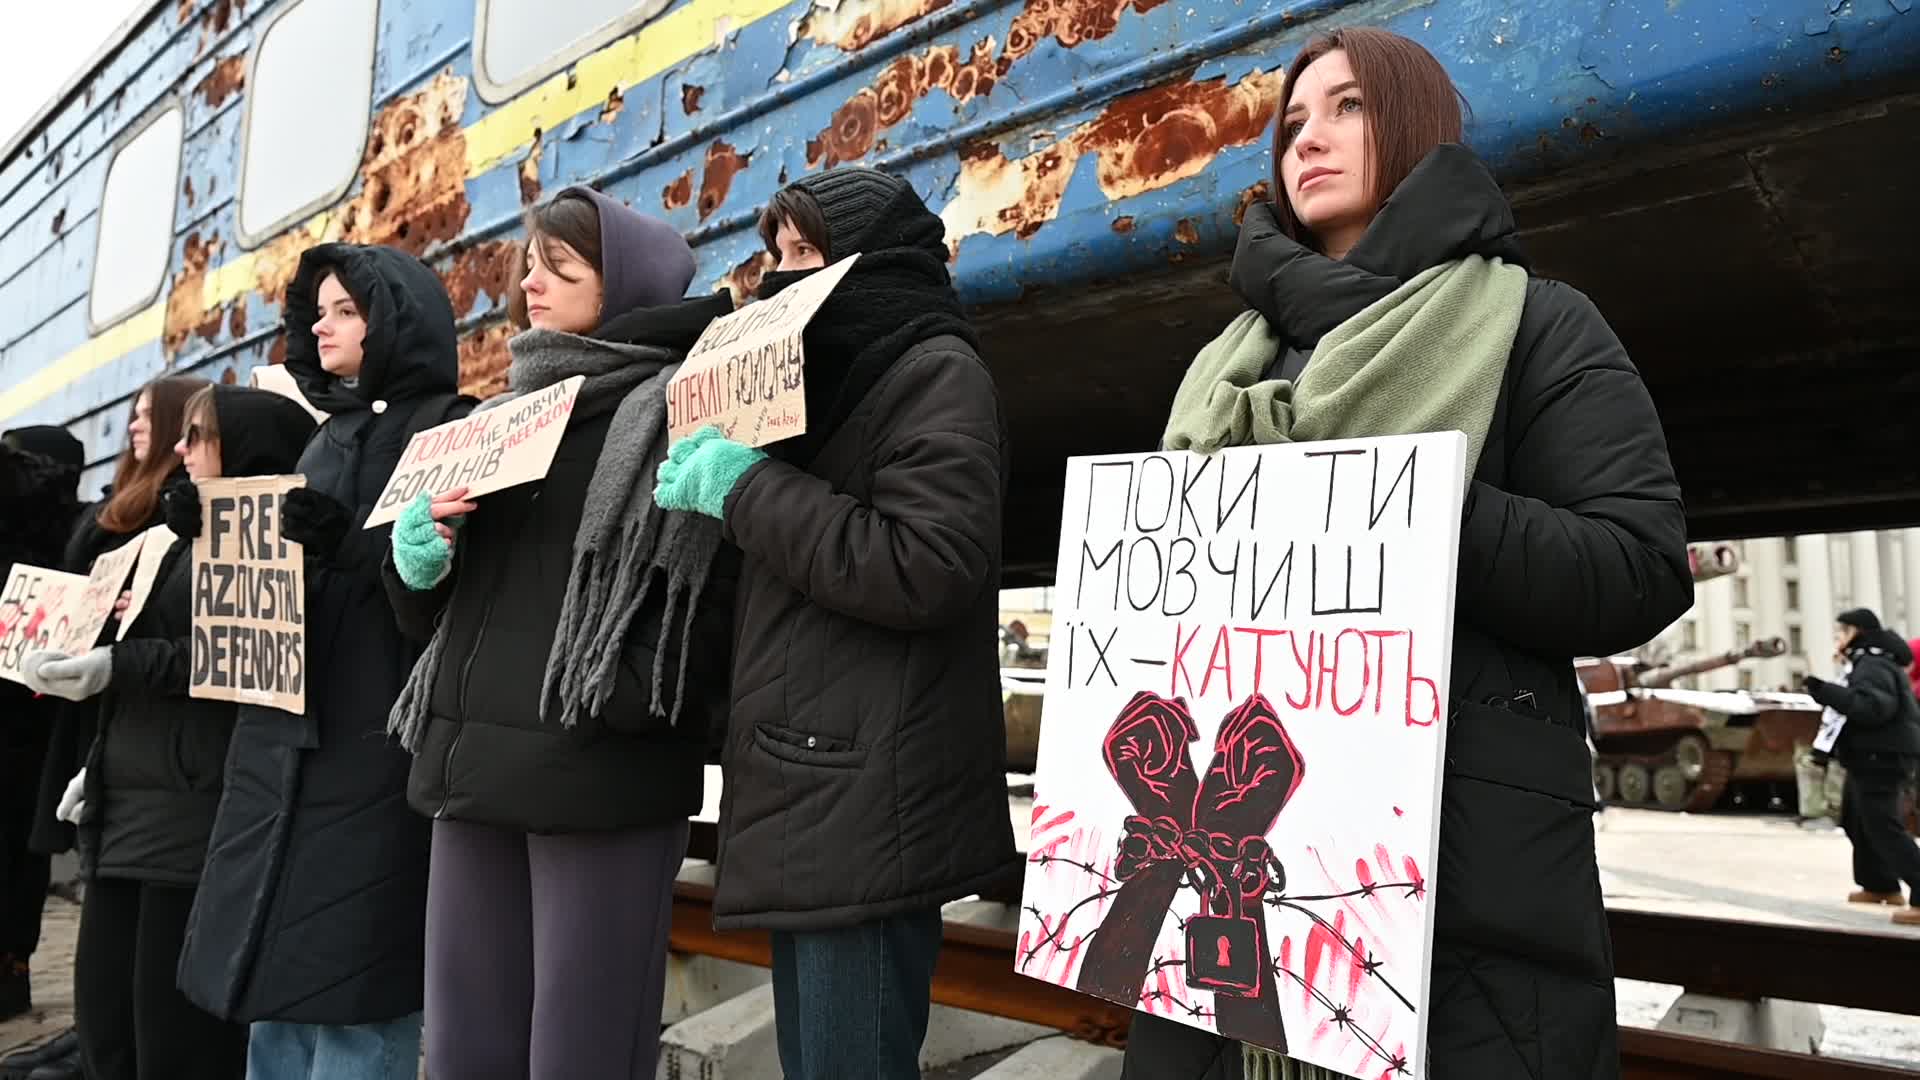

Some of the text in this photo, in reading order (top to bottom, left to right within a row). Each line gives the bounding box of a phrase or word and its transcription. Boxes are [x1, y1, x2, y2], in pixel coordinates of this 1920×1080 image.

[726, 331, 802, 411] ПОЛОНУ
[401, 413, 493, 469] ПОЛОН
[479, 382, 567, 450] НЕ МОВЧИ
[501, 421, 533, 449] FREE
[1086, 446, 1417, 537] ПОКИ ТИ
[194, 562, 302, 624] AZOVSTAL
[1076, 536, 1385, 620] МОВЧИШ
[192, 625, 302, 695] DEFENDERS
[1066, 621, 1118, 689] ЇХ
[1171, 621, 1440, 727] КАТУЮТЬ
